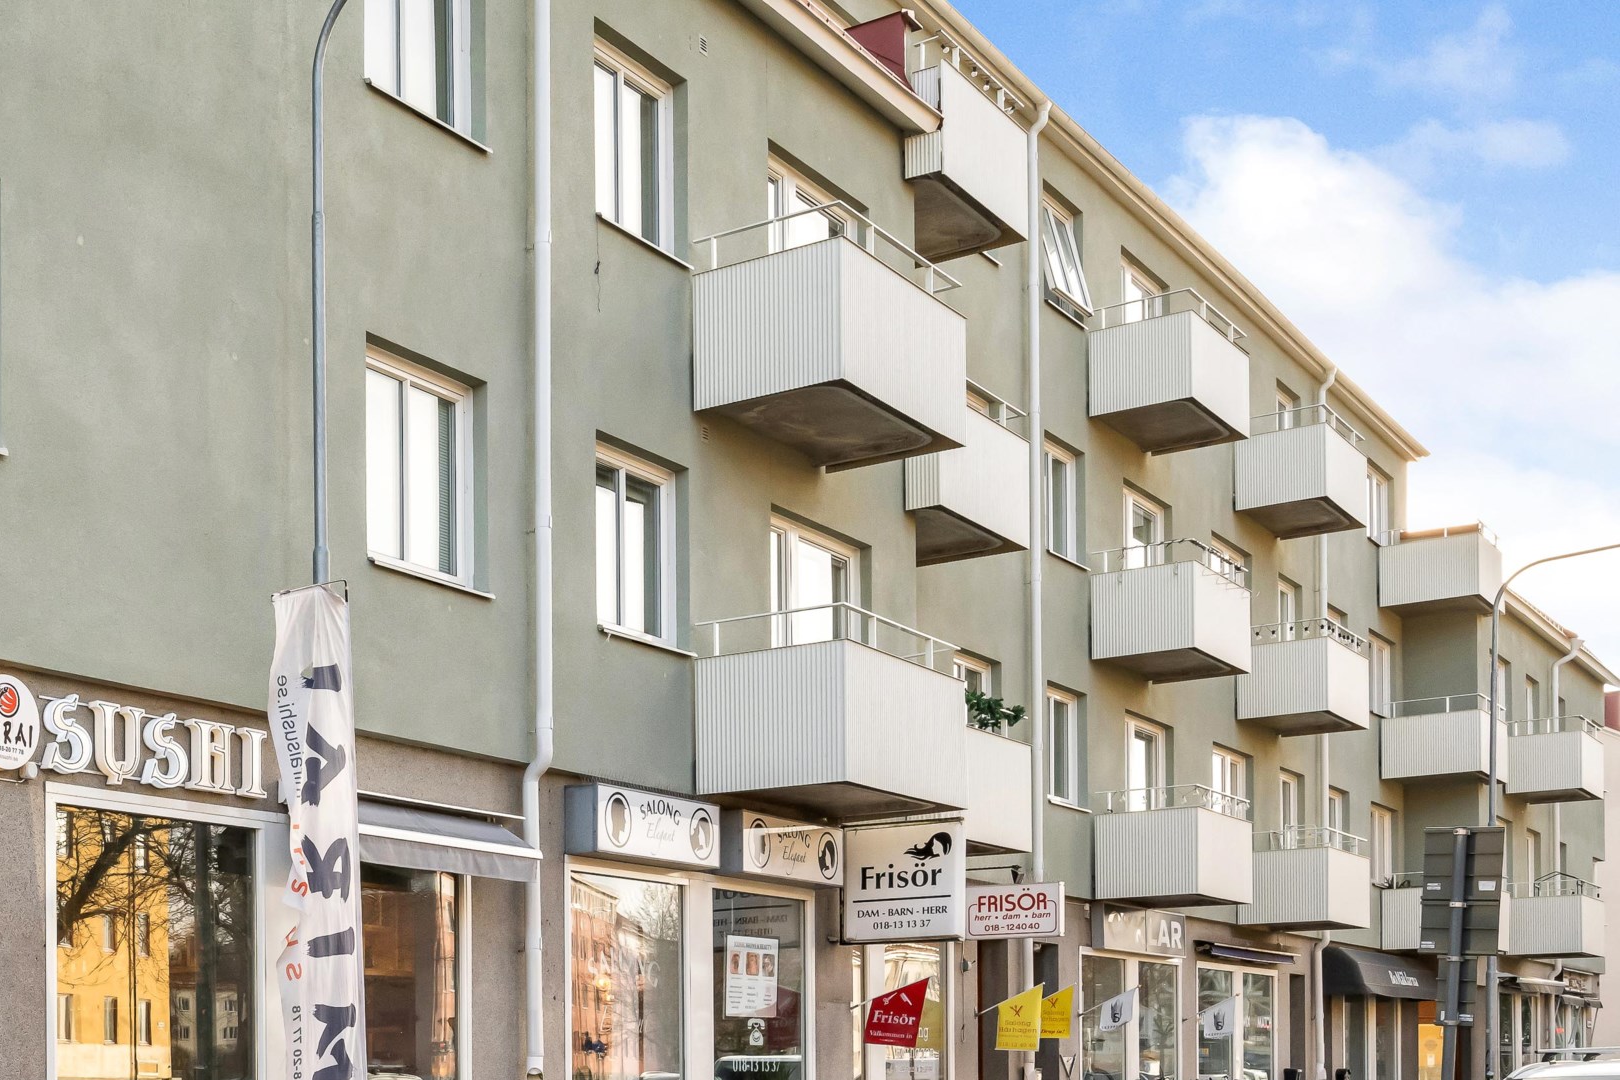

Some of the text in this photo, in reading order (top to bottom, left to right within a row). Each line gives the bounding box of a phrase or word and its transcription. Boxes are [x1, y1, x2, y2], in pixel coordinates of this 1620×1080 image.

[40, 693, 267, 798] SUSHI
[640, 799, 681, 826] SALONG
[777, 825, 811, 848] SALONG
[860, 862, 942, 890] Frisör
[977, 888, 1048, 913] FRISÖR
[857, 909, 879, 918] DAM
[888, 908, 914, 917] BARN
[922, 906, 947, 915] HERR
[1002, 912, 1020, 920] dam
[1031, 911, 1051, 919] barn
[873, 920, 931, 930] 018-13 13 37
[872, 1010, 916, 1026] Frisör
[869, 1029, 905, 1039] Välkommen
